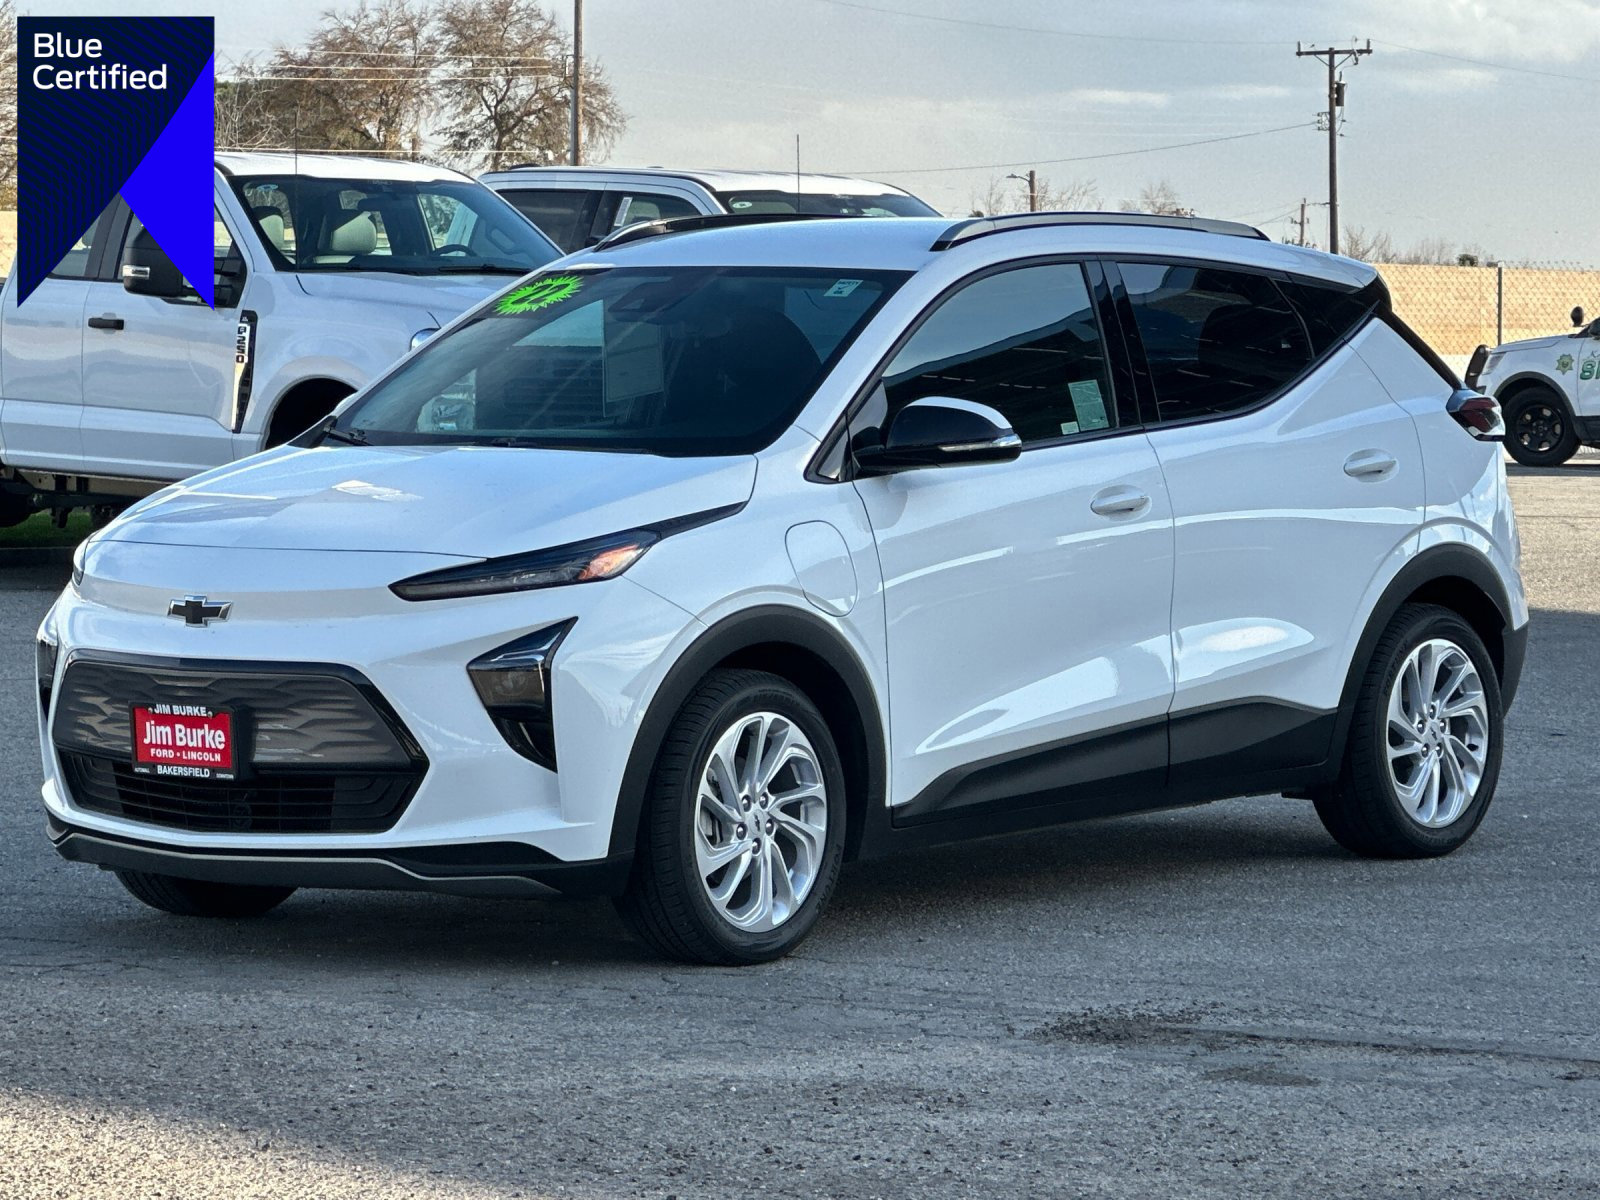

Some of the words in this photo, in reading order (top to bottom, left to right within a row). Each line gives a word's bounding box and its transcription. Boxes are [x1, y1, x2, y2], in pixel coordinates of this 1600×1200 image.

[154, 704, 171, 714] JIM
[172, 705, 207, 717] BURKE
[143, 720, 172, 745] Jim
[175, 724, 225, 749] Burke
[150, 748, 174, 759] FORD
[182, 750, 221, 762] LINCOLN
[157, 765, 210, 778] BAKERSFIELD
